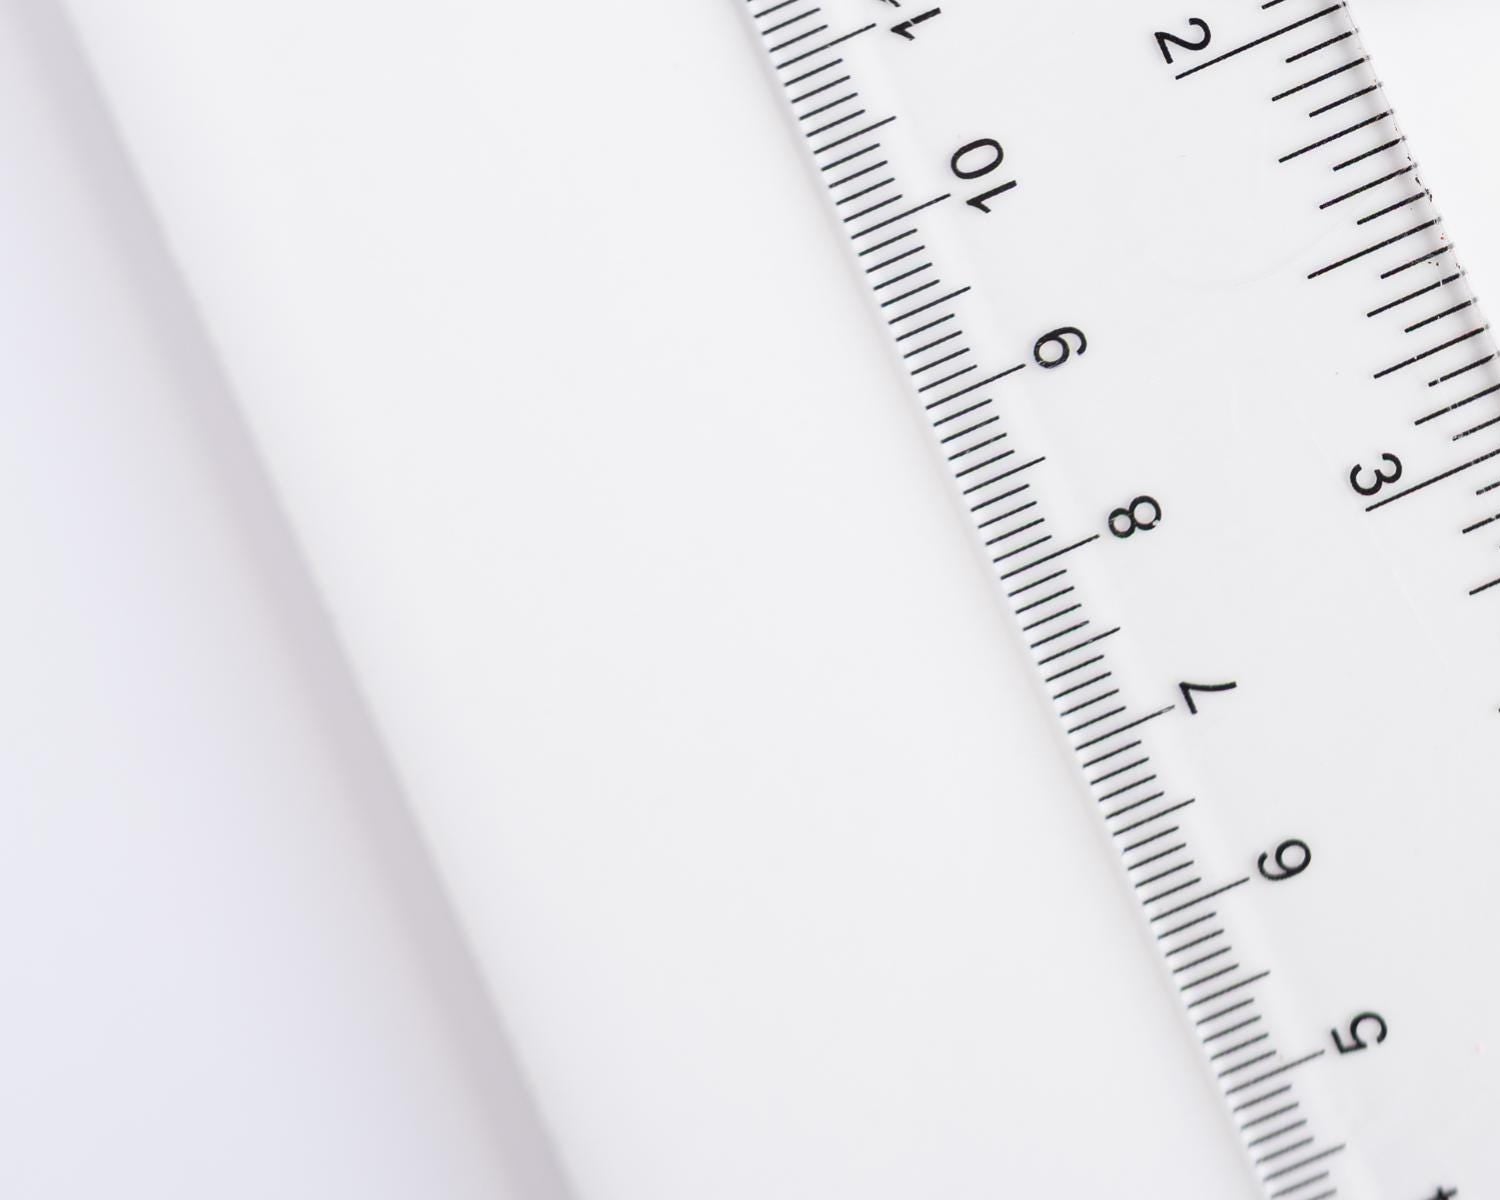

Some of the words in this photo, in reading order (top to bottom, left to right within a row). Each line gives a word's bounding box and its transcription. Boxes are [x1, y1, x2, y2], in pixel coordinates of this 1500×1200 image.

[1153, 17, 1212, 65] 2
[950, 137, 1018, 214] 10
[1033, 326, 1088, 370] 9
[1349, 452, 1403, 497] 3
[1107, 495, 1162, 540] 8
[1178, 680, 1238, 715] 7
[1257, 838, 1312, 882] 6
[1330, 1011, 1388, 1055] 5
